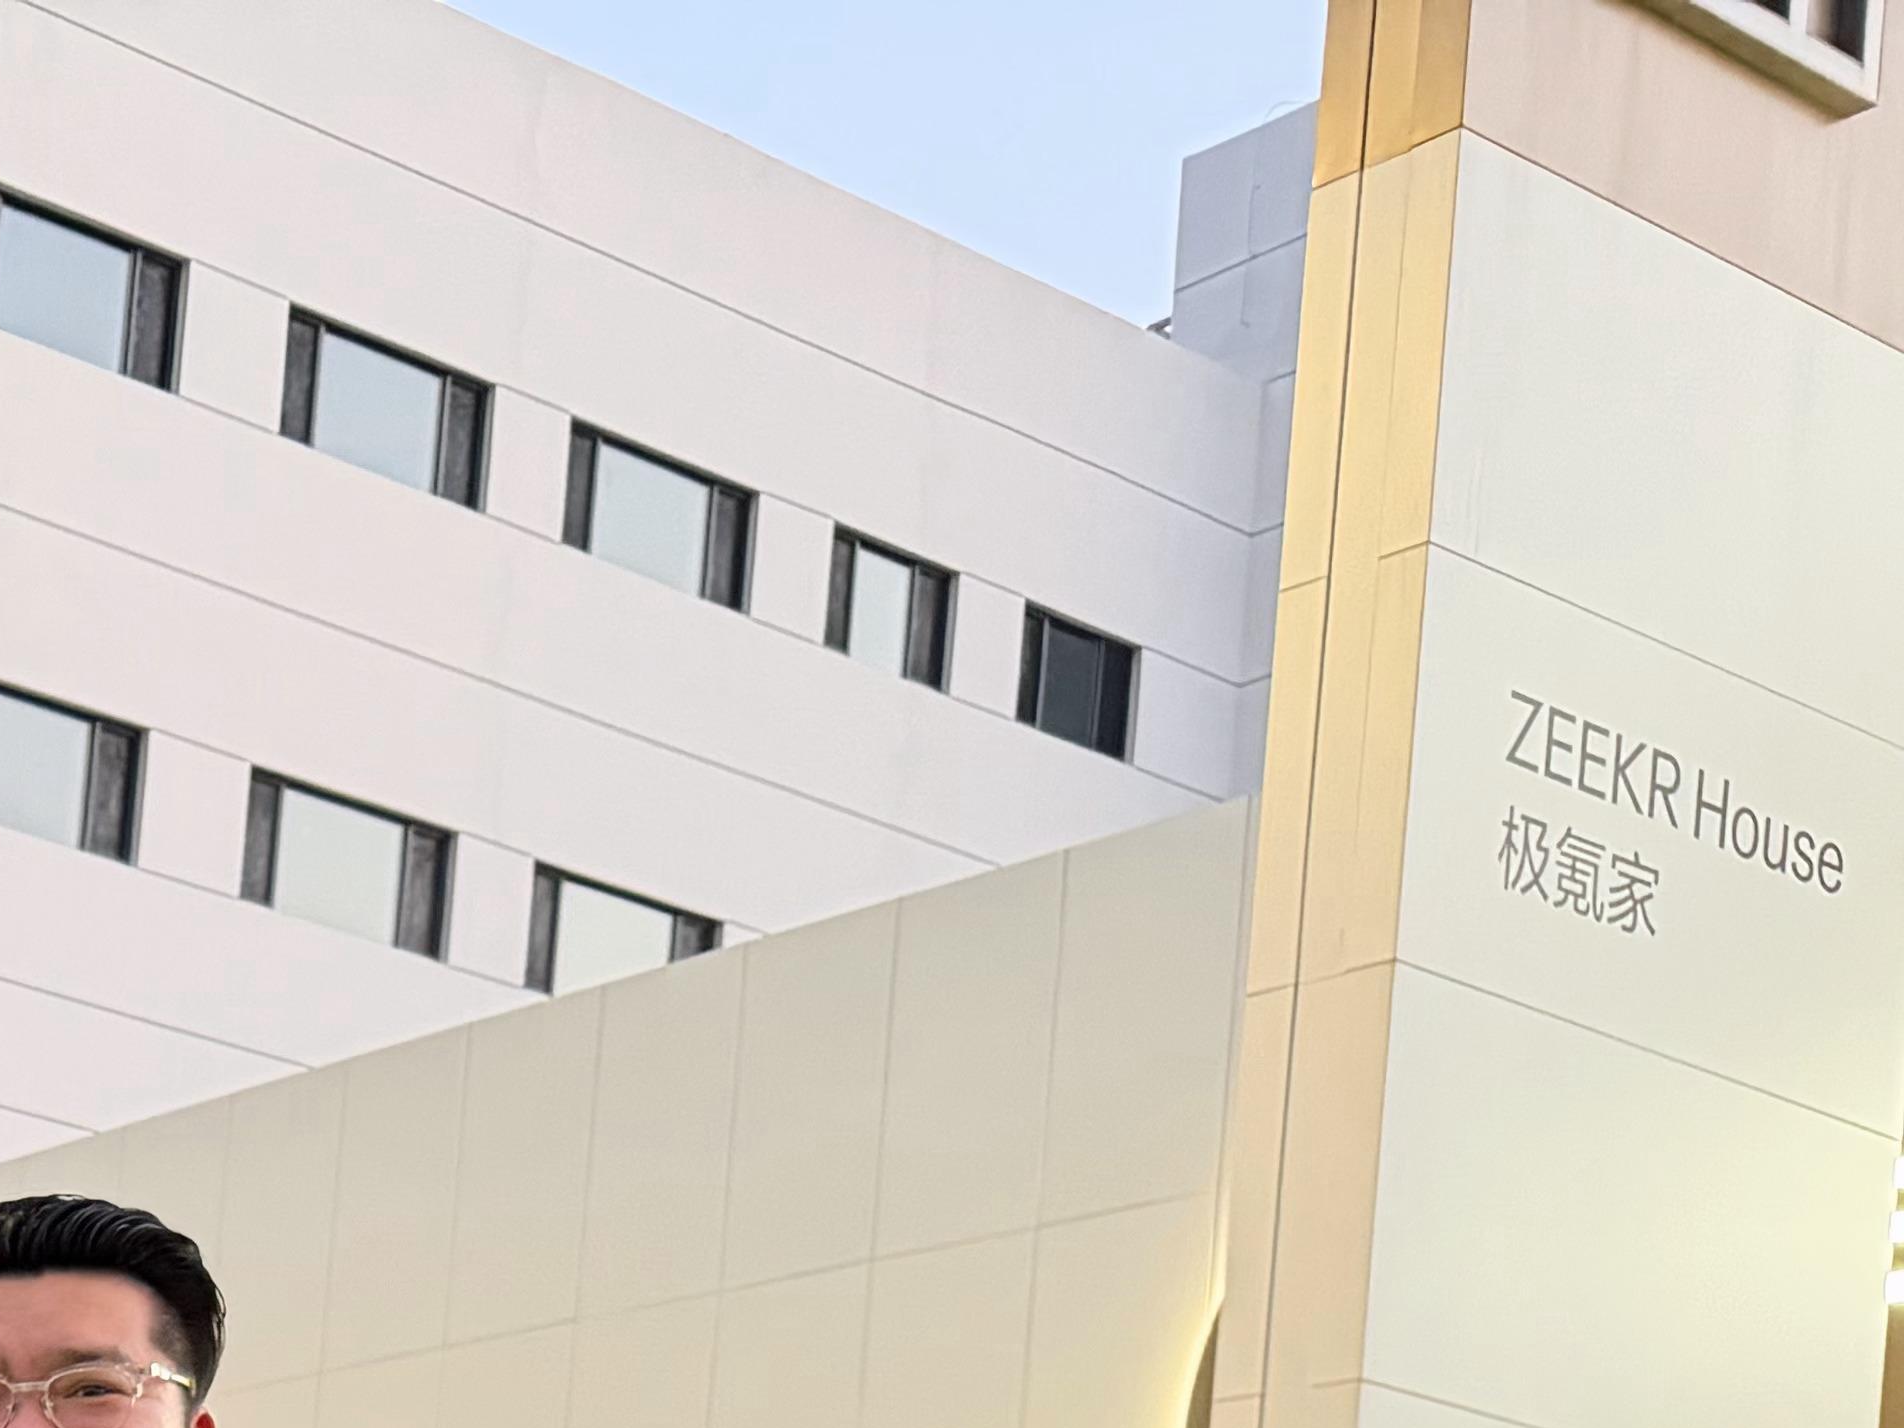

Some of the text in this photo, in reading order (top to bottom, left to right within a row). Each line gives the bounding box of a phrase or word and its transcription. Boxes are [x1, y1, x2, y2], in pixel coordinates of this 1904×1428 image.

[1497, 805, 1660, 936] 极氪家
[1506, 690, 1844, 894] ZEEKR House
